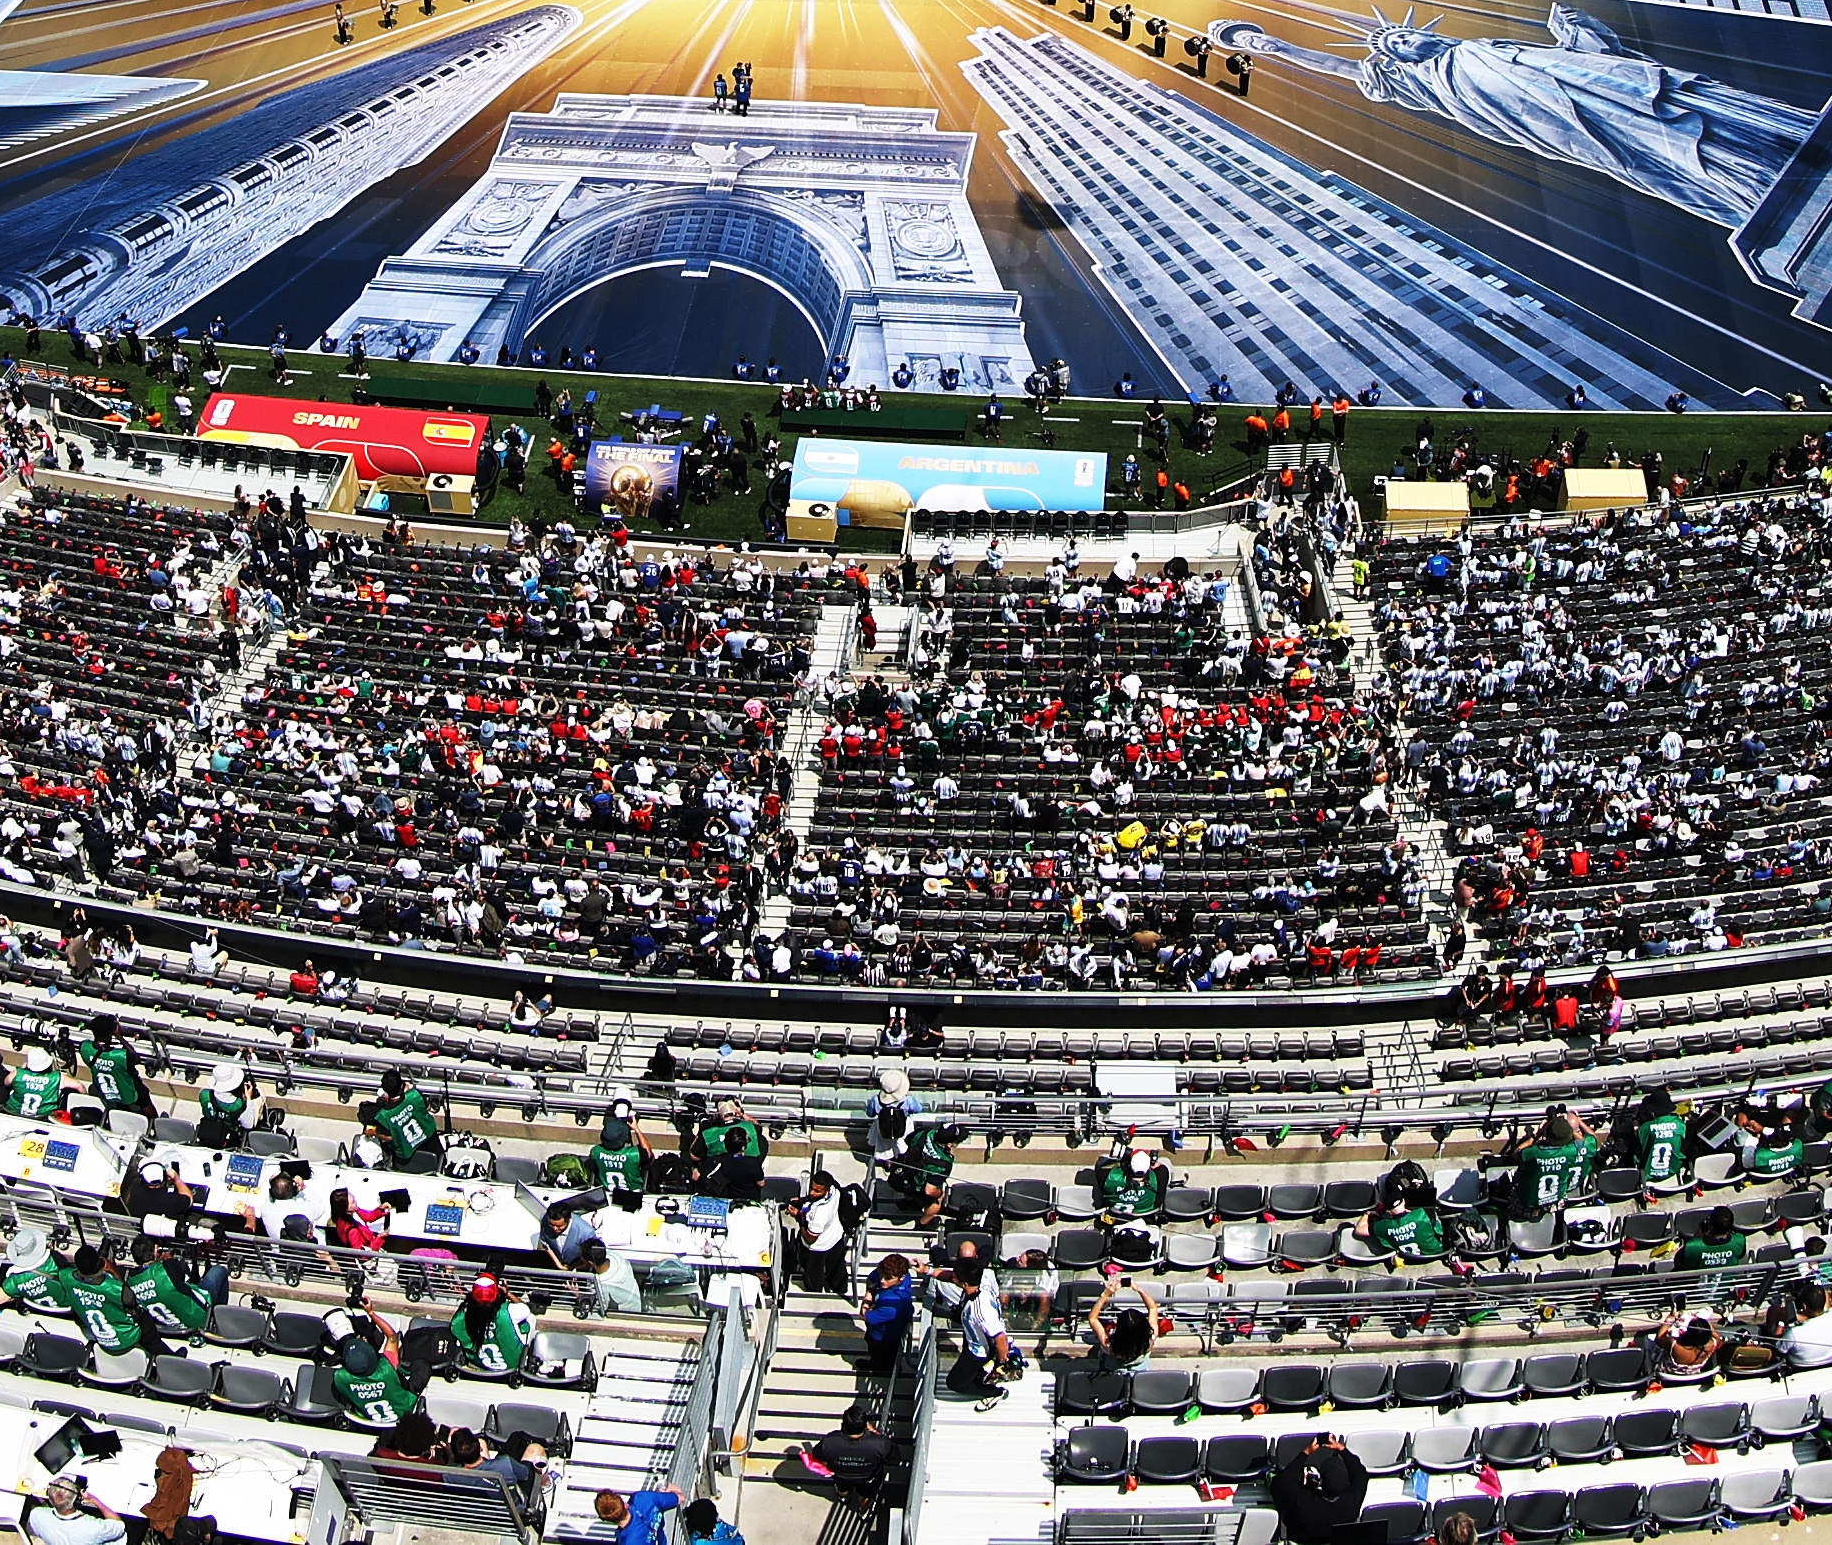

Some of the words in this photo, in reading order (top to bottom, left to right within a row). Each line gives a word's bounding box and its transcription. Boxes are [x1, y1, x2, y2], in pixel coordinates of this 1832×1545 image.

[292, 411, 361, 430] SPAIN
[597, 451, 626, 461] THE
[628, 453, 674, 464] FINAL
[899, 455, 1040, 476] ARGENTINA
[1650, 1122, 1677, 1131] PHOTO
[27, 1141, 45, 1153] 28
[598, 1151, 627, 1160] PHOTO
[1536, 1156, 1567, 1165] PHOTO
[1386, 1222, 1418, 1235] PHOTO
[1700, 1250, 1733, 1259] PHOTO
[17, 1276, 47, 1291] PHOTO
[130, 1279, 158, 1292] PHOTO
[74, 1288, 107, 1301] PHOTO
[350, 1382, 385, 1392] PHOTO
